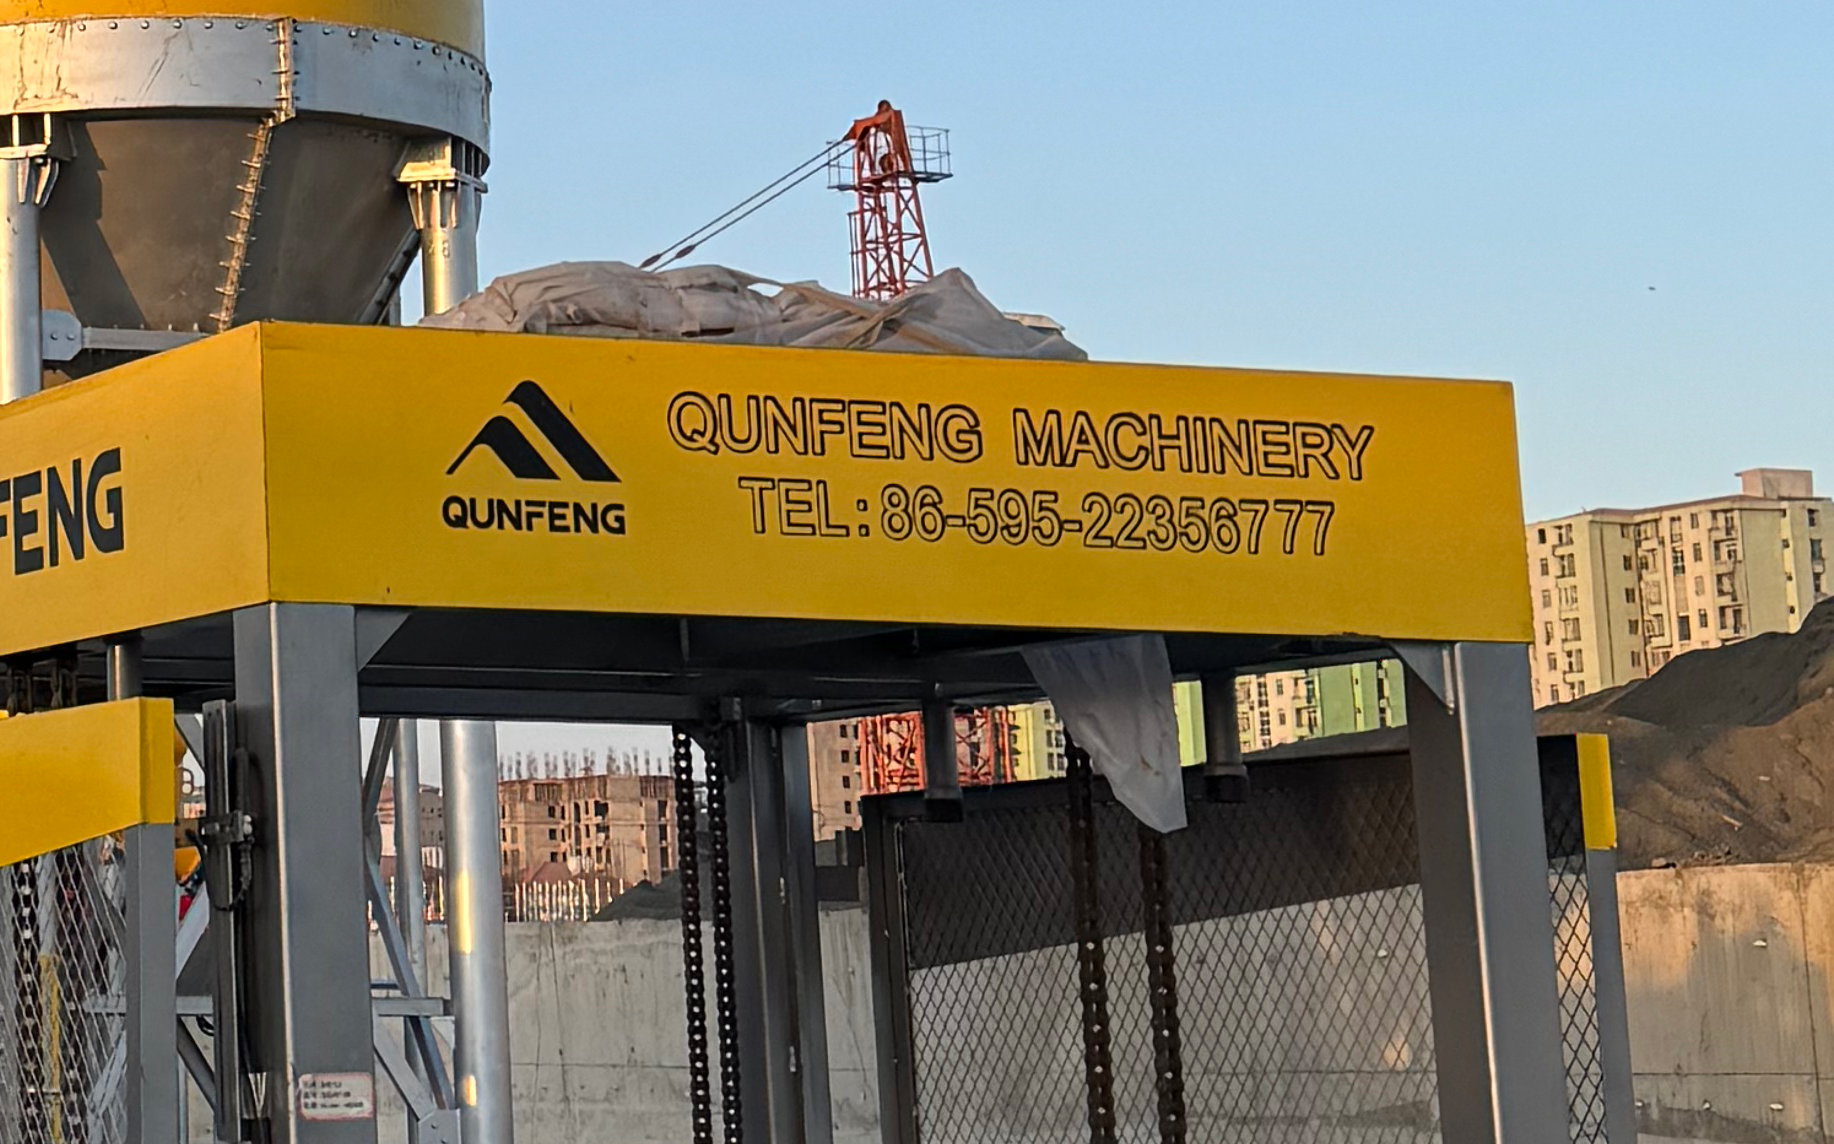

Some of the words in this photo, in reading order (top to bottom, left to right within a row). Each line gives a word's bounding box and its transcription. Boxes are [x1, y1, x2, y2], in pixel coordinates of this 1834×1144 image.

[667, 390, 984, 464] QUNFENG
[1012, 407, 1375, 481] MACHINERY
[441, 495, 627, 536] QUNFENG
